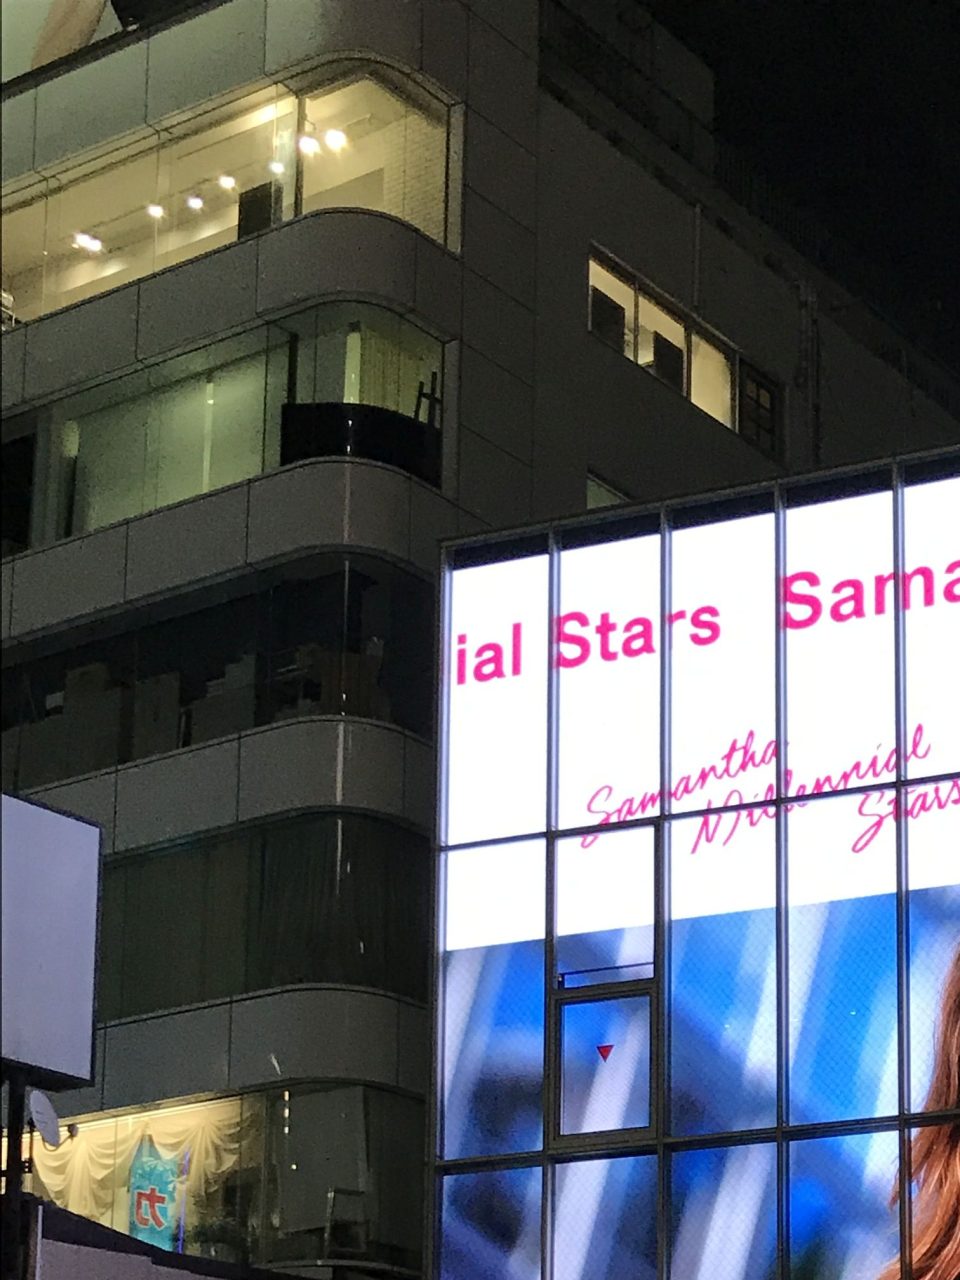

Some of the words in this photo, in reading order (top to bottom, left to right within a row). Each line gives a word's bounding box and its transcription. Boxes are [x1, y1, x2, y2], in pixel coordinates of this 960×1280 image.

[456, 622, 523, 685] ial
[552, 605, 721, 670] Stars
[580, 730, 790, 849] Samantha
